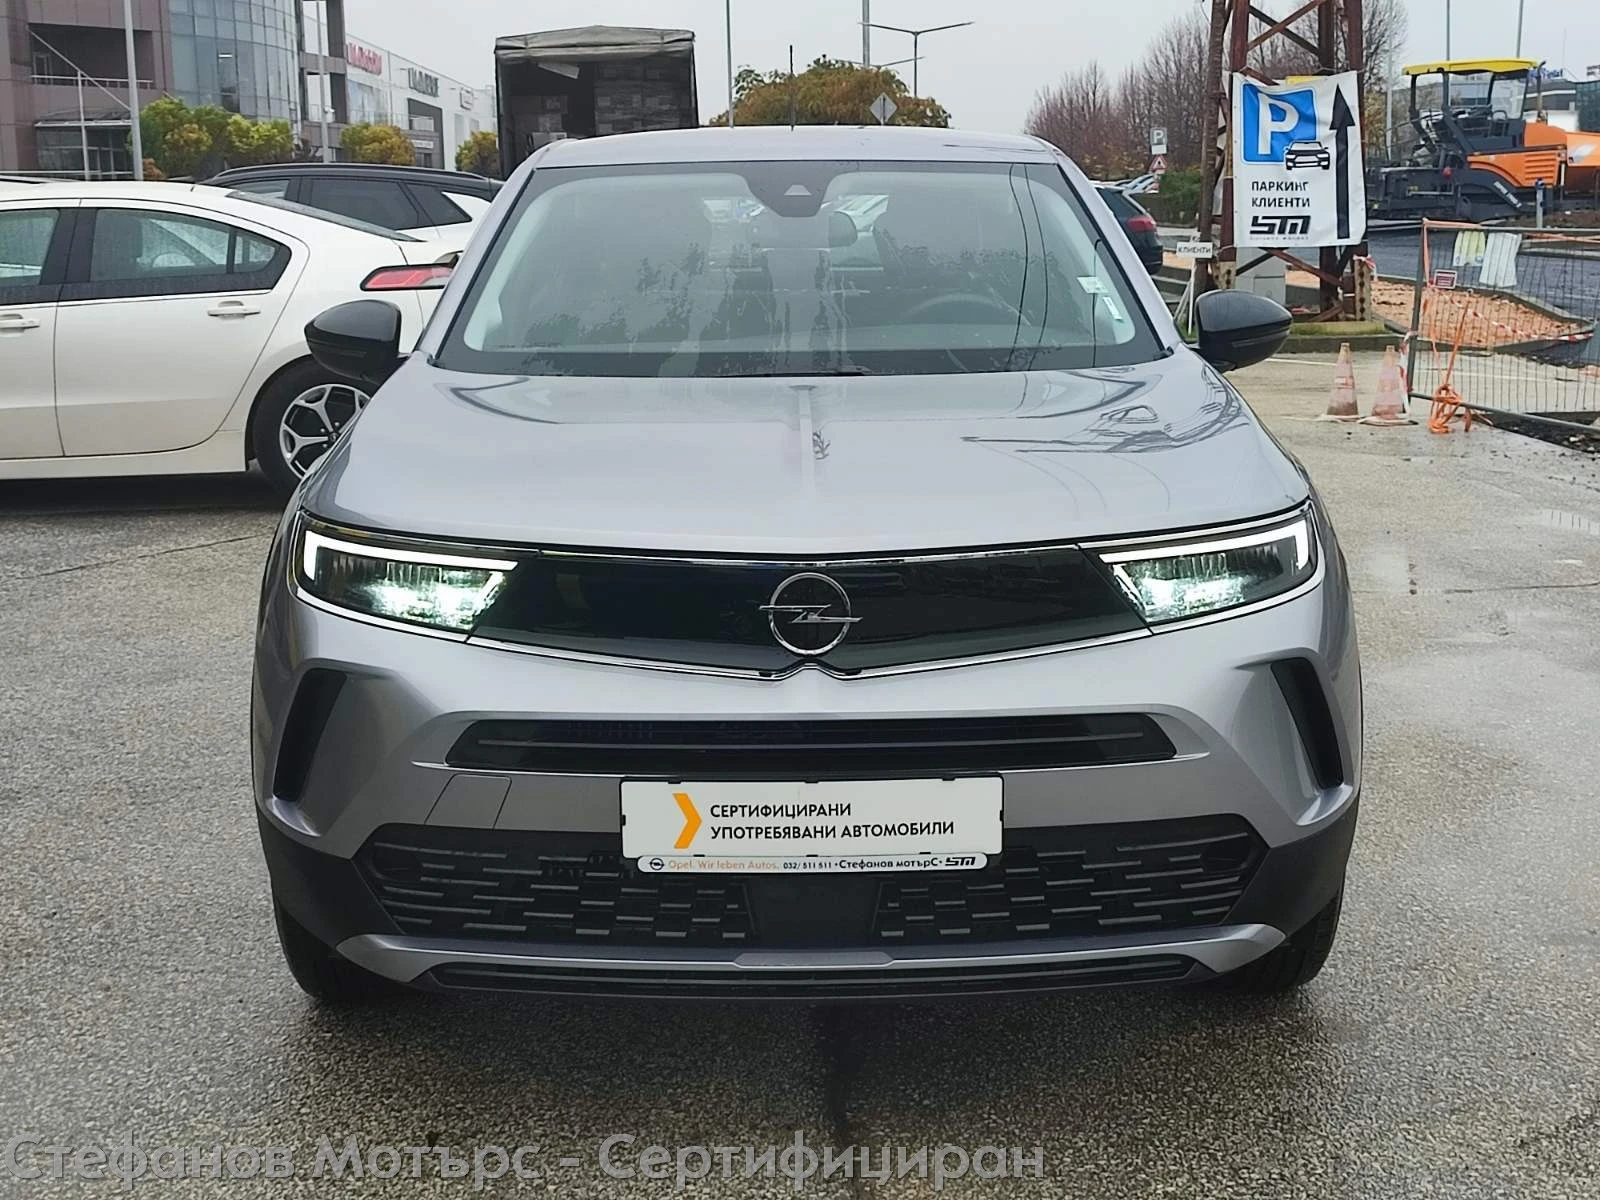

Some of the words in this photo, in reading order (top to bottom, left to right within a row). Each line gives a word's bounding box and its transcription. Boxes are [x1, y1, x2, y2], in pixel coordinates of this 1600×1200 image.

[1257, 93, 1300, 156] P
[1153, 130, 1164, 144] P
[1251, 181, 1309, 192] ПАРКИНГ
[1251, 197, 1311, 208] КЛИЕНТИ
[709, 803, 852, 819] СЕРТИФИЦИРАНИ
[710, 824, 837, 841] УПОТРЕБЯВАНИ
[840, 822, 955, 839] АВТОМОБИЛИ
[698, 860, 714, 869] Wir
[717, 860, 745, 869] leben
[803, 862, 816, 870] 511
